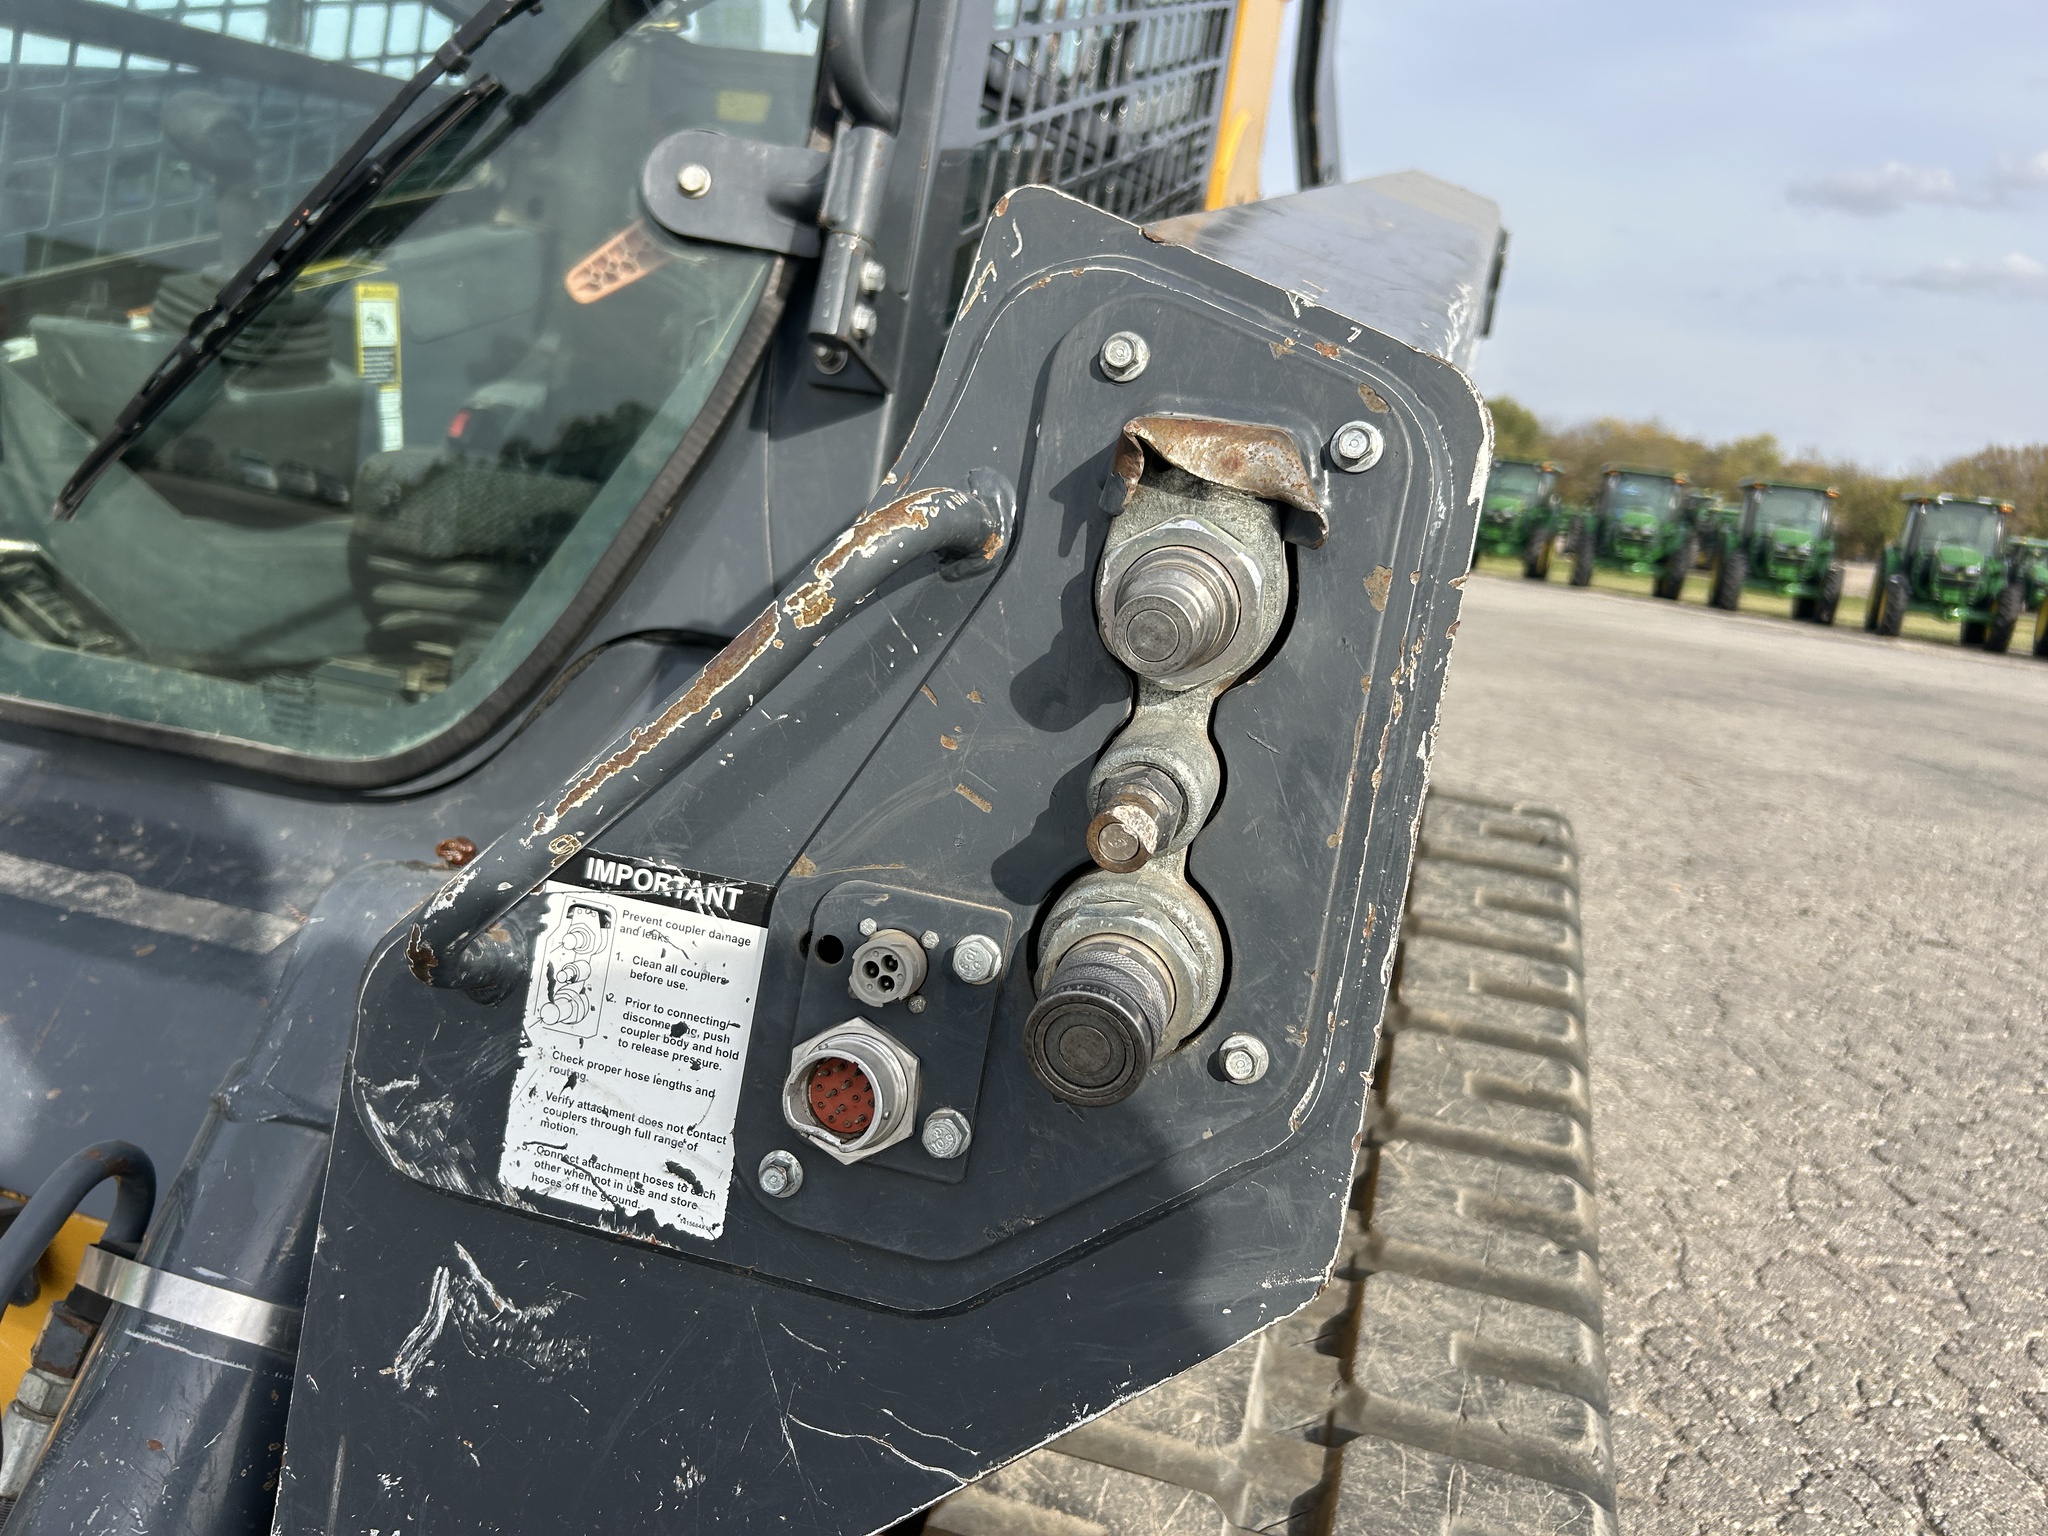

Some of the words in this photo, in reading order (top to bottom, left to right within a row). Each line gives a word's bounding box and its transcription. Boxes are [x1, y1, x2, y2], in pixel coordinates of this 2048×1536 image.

[585, 857, 744, 911] IMPORTANT
[620, 925, 640, 936] and
[642, 929, 670, 943] leaks
[622, 910, 663, 927] Prevent
[666, 920, 706, 936] coupler
[708, 929, 751, 947] damage
[615, 952, 624, 962] 1.
[632, 955, 662, 970] Clean
[664, 963, 678, 974] all
[680, 967, 726, 985] couplers
[630, 969, 663, 985] before
[666, 978, 689, 991] use.
[607, 992, 617, 1003] 2.
[624, 996, 651, 1011] Prior
[654, 1004, 664, 1014] to
[620, 1025, 661, 1043] coupler
[662, 1035, 690, 1050] body
[692, 1042, 712, 1054] and
[715, 1045, 740, 1061] hold
[622, 1010, 700, 1038] disconneng,
[703, 1029, 731, 1044] push
[618, 1038, 628, 1048] to
[631, 1042, 670, 1058] release
[672, 1051, 722, 1071] pressure.
[552, 1050, 584, 1066] Check
[586, 1060, 622, 1076] proper
[624, 1068, 650, 1082] hose
[652, 1074, 692, 1092] lengths
[695, 1089, 716, 1098] and
[540, 1119, 578, 1136] motion.
[543, 1106, 588, 1124] couplers
[590, 1116, 631, 1136] through
[634, 1128, 652, 1140] full
[654, 1134, 684, 1148] range
[687, 1142, 698, 1152] of
[546, 1090, 575, 1108] Verify
[577, 1100, 636, 1122] attachment
[638, 1115, 664, 1128] does
[666, 1123, 684, 1134] not
[687, 1128, 726, 1145] contact
[522, 1142, 530, 1152] 5.
[536, 1146, 580, 1164] Connect
[582, 1158, 640, 1180] attachment
[642, 1172, 674, 1189] hoses
[678, 1183, 688, 1192] to
[534, 1160, 561, 1174] other
[564, 1168, 590, 1182] when
[594, 1176, 611, 1187] not
[614, 1180, 623, 1190] in
[626, 1184, 645, 1196] use
[648, 1190, 668, 1201] and
[670, 1196, 698, 1209] store
[532, 1172, 562, 1188] hoses
[565, 1182, 580, 1192] off
[582, 1186, 598, 1197] the
[600, 1192, 641, 1209] ground.
